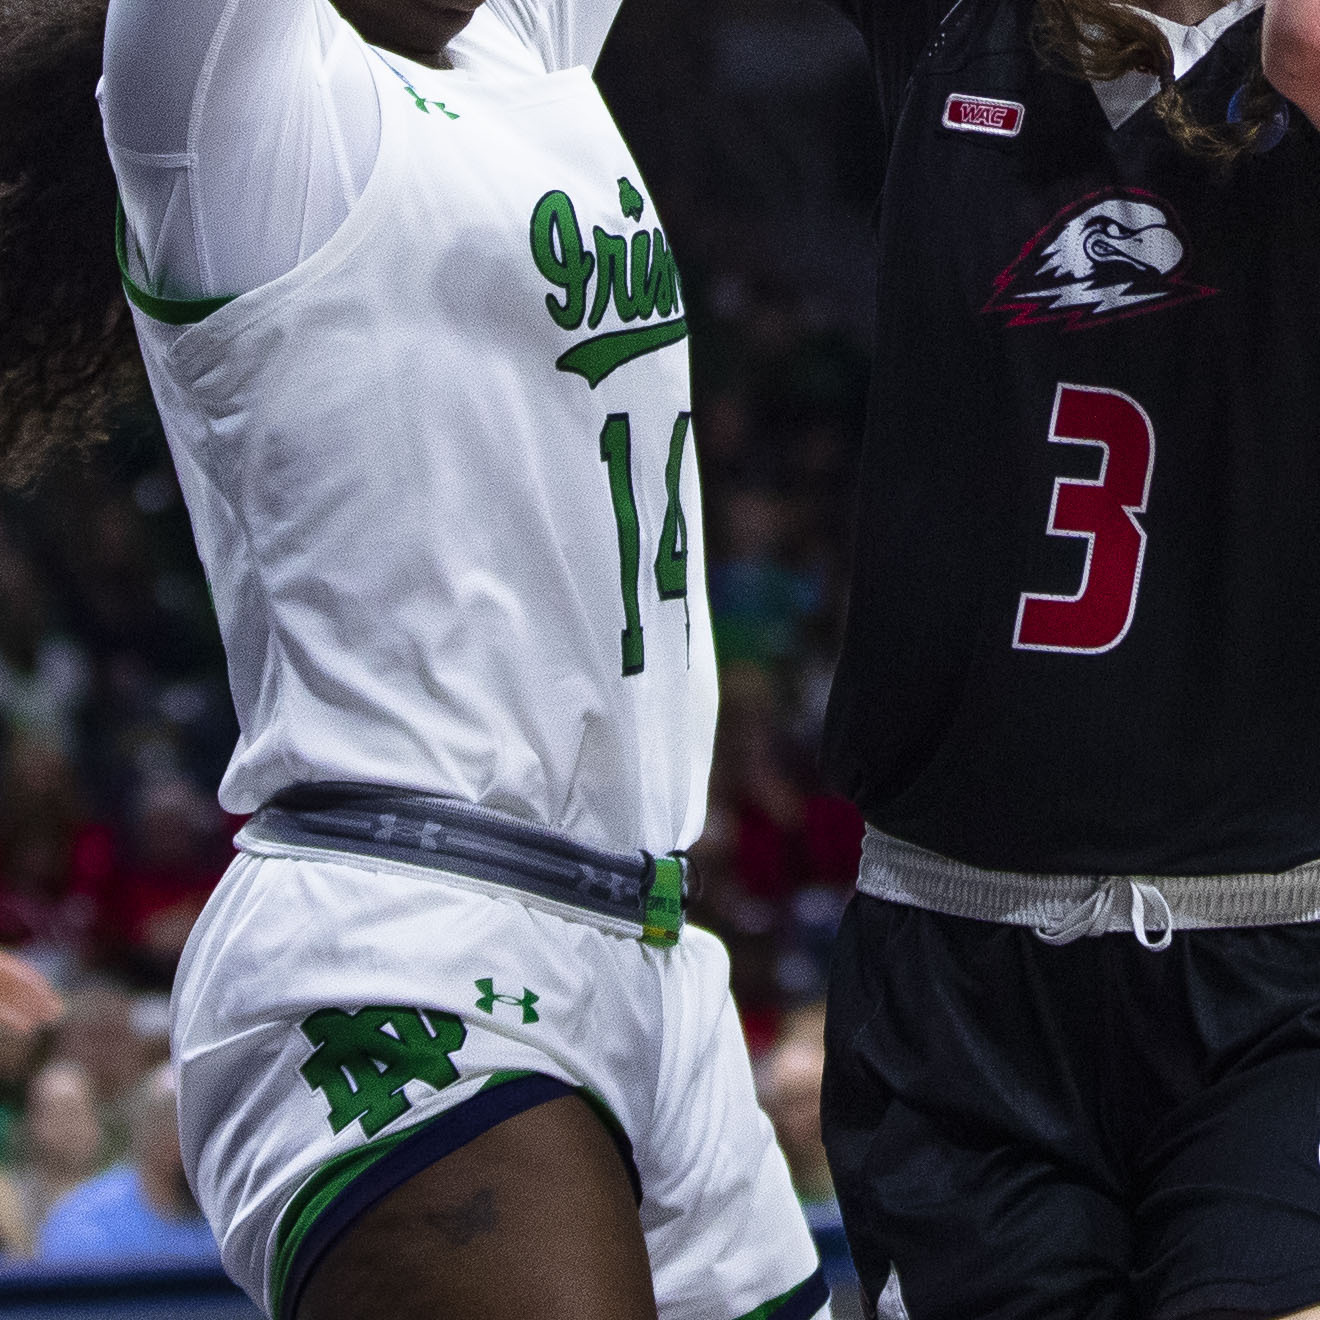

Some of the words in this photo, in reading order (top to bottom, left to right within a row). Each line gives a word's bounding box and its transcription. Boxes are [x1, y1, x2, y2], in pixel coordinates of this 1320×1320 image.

[959, 102, 1008, 129] WAC
[599, 411, 692, 678] 14
[1012, 382, 1155, 656] 3
